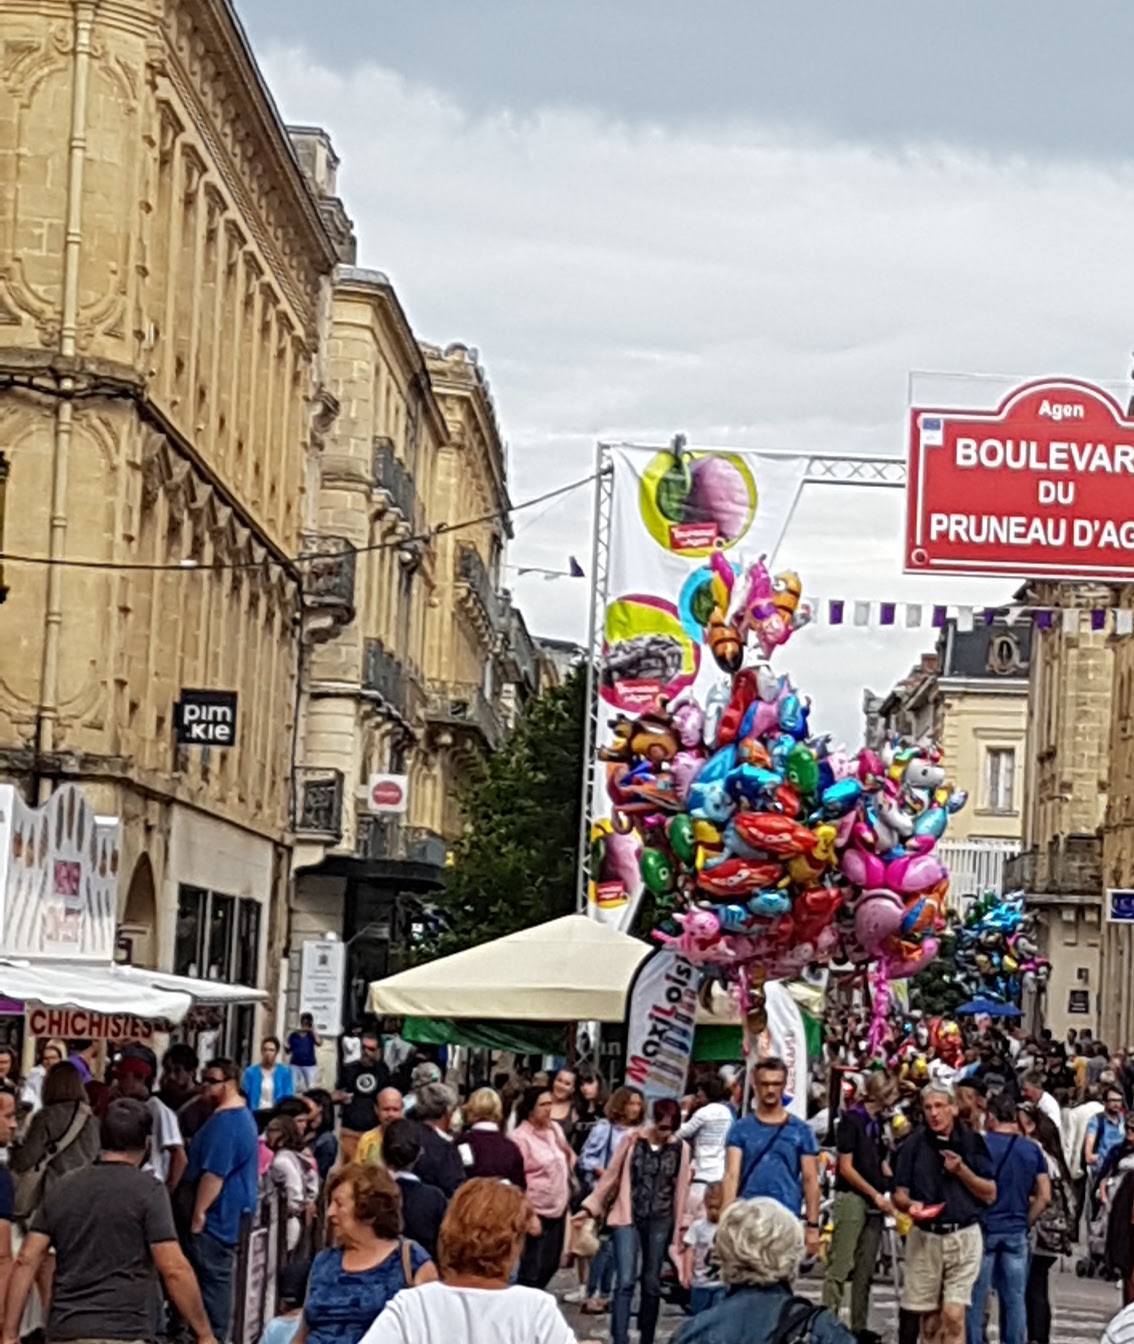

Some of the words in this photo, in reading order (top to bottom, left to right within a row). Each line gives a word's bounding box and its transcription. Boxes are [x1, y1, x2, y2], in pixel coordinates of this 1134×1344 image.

[1038, 399, 1084, 421] Agen
[1038, 480, 1075, 504] DU
[930, 513, 1066, 547] PRUNEAU
[183, 704, 232, 725] pim
